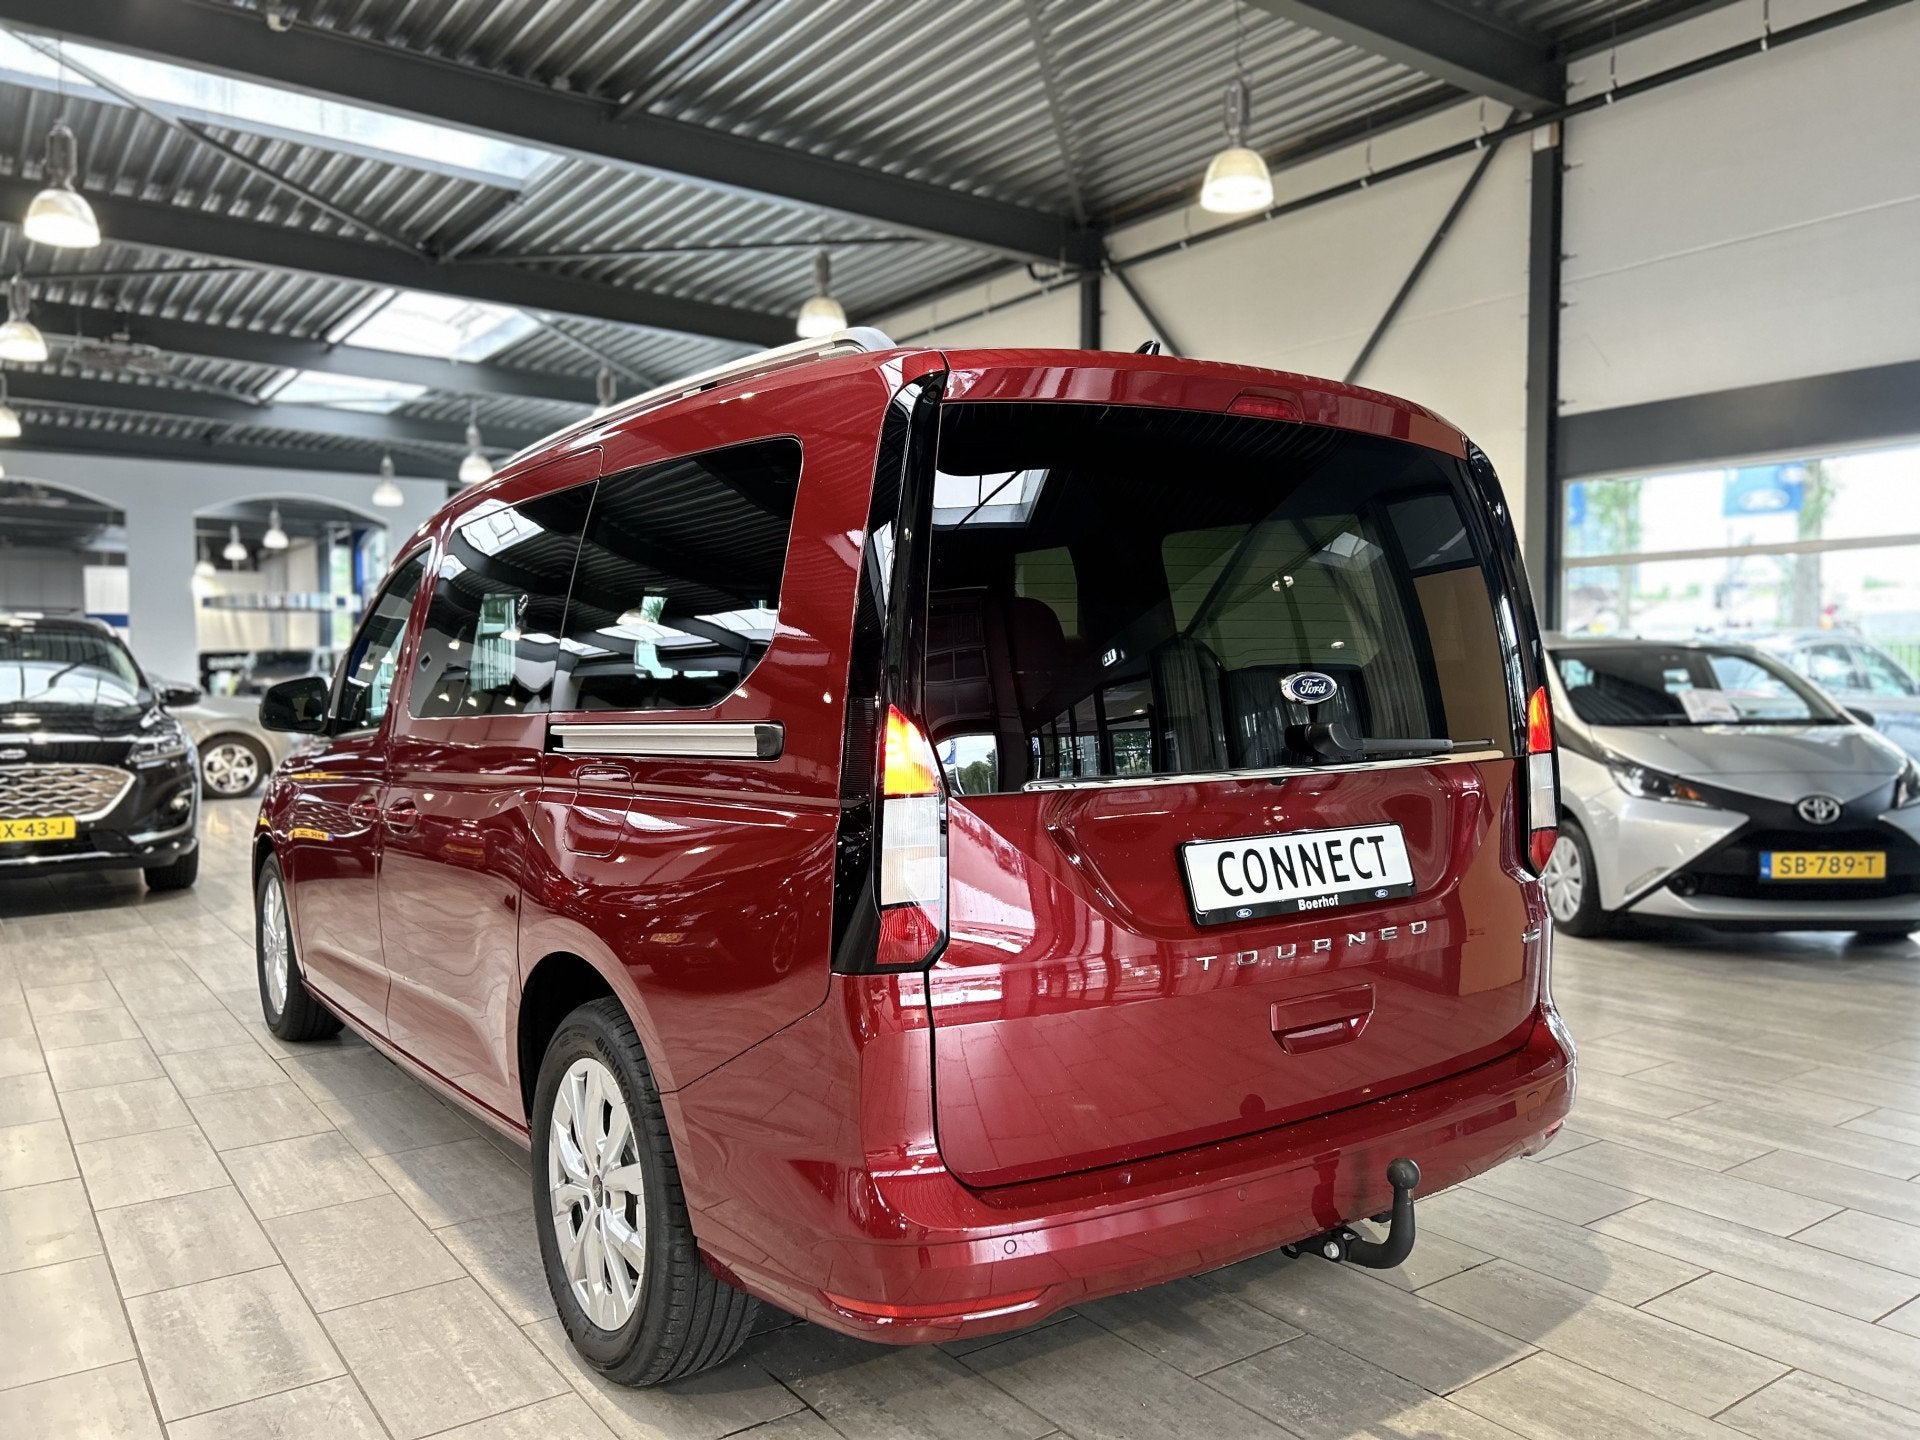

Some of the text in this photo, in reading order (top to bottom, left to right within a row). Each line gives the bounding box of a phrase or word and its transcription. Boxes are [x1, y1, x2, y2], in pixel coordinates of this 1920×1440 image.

[1300, 678, 1327, 695] Ford
[0, 820, 66, 838] X-43-J
[1217, 835, 1387, 897] CONNECT
[1779, 856, 1876, 875] SB-789-T
[1298, 894, 1339, 911] Boerhof
[1196, 920, 1427, 972] TOURNEO
